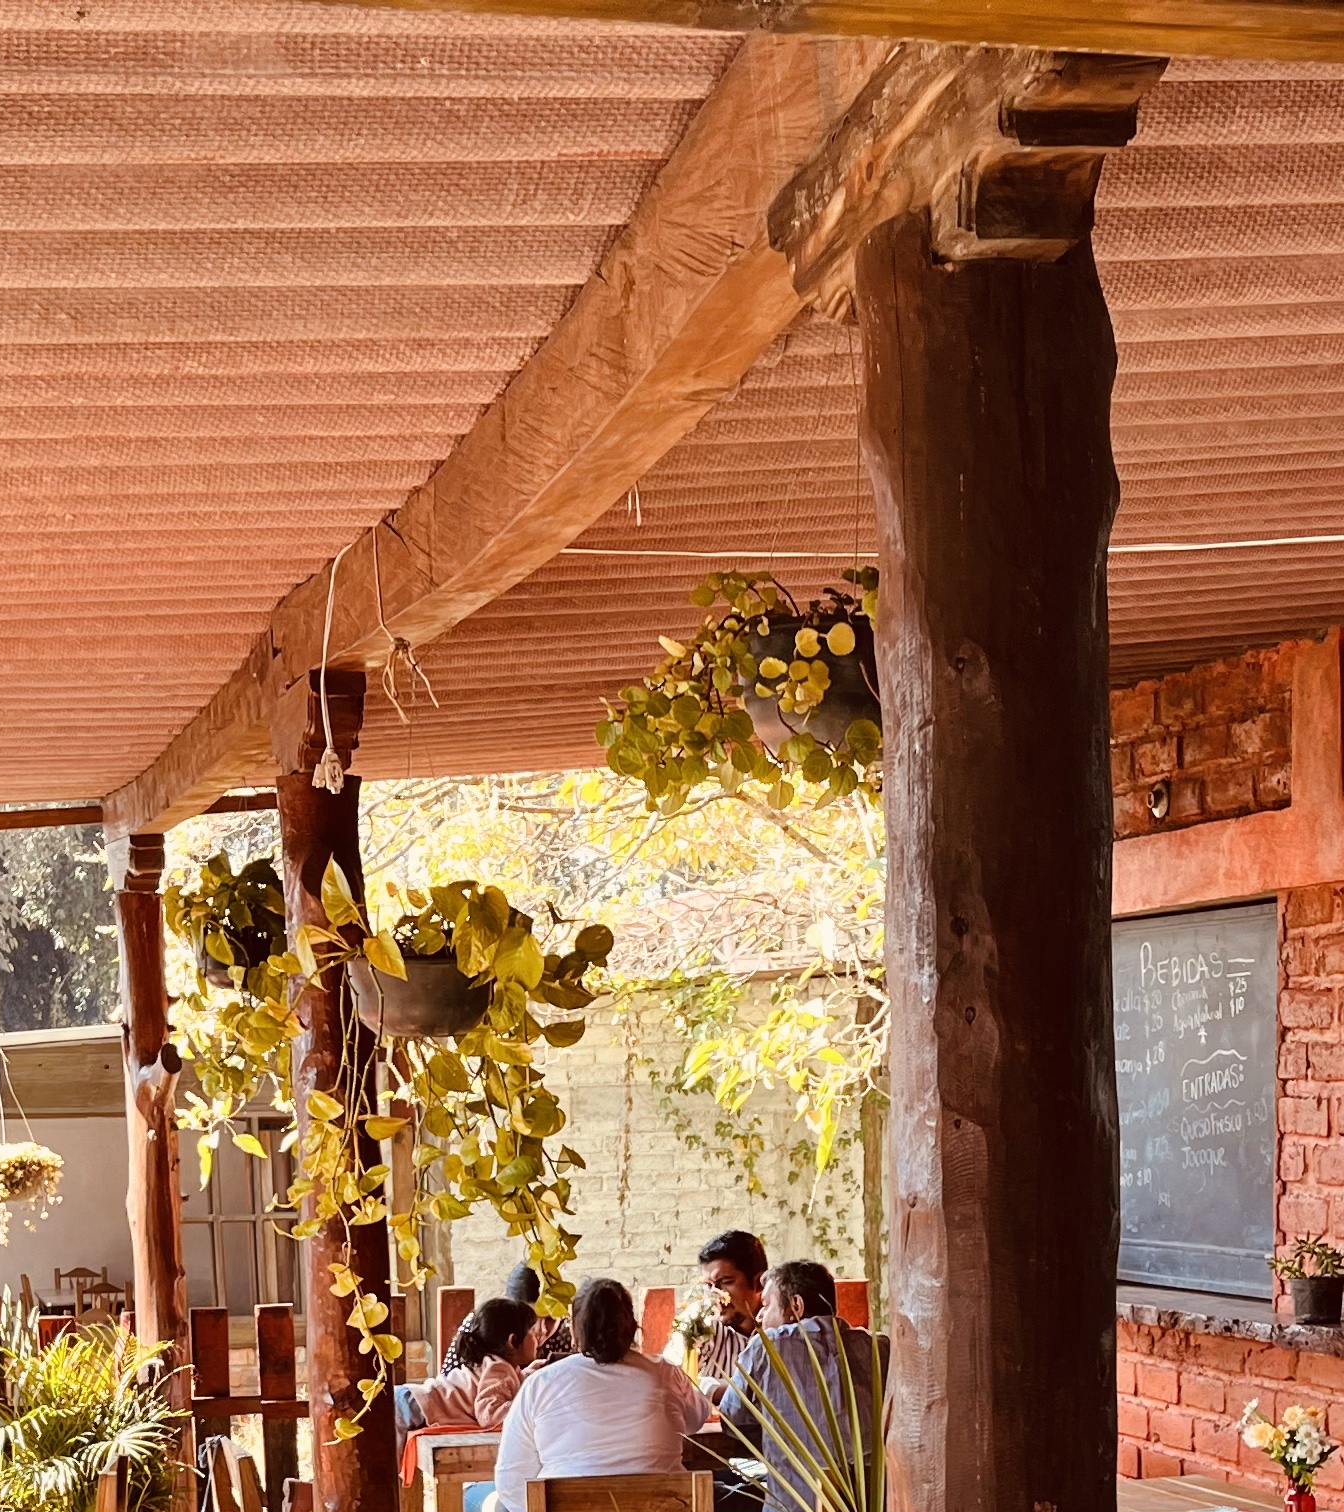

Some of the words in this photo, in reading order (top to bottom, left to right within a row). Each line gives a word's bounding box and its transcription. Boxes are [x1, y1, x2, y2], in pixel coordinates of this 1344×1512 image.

[1140, 942, 1223, 988] BEBIDAS
[1229, 977, 1247, 997] $25
[1182, 1064, 1245, 1102] ENTRADAS:
[1181, 1116, 1210, 1145] Queso
